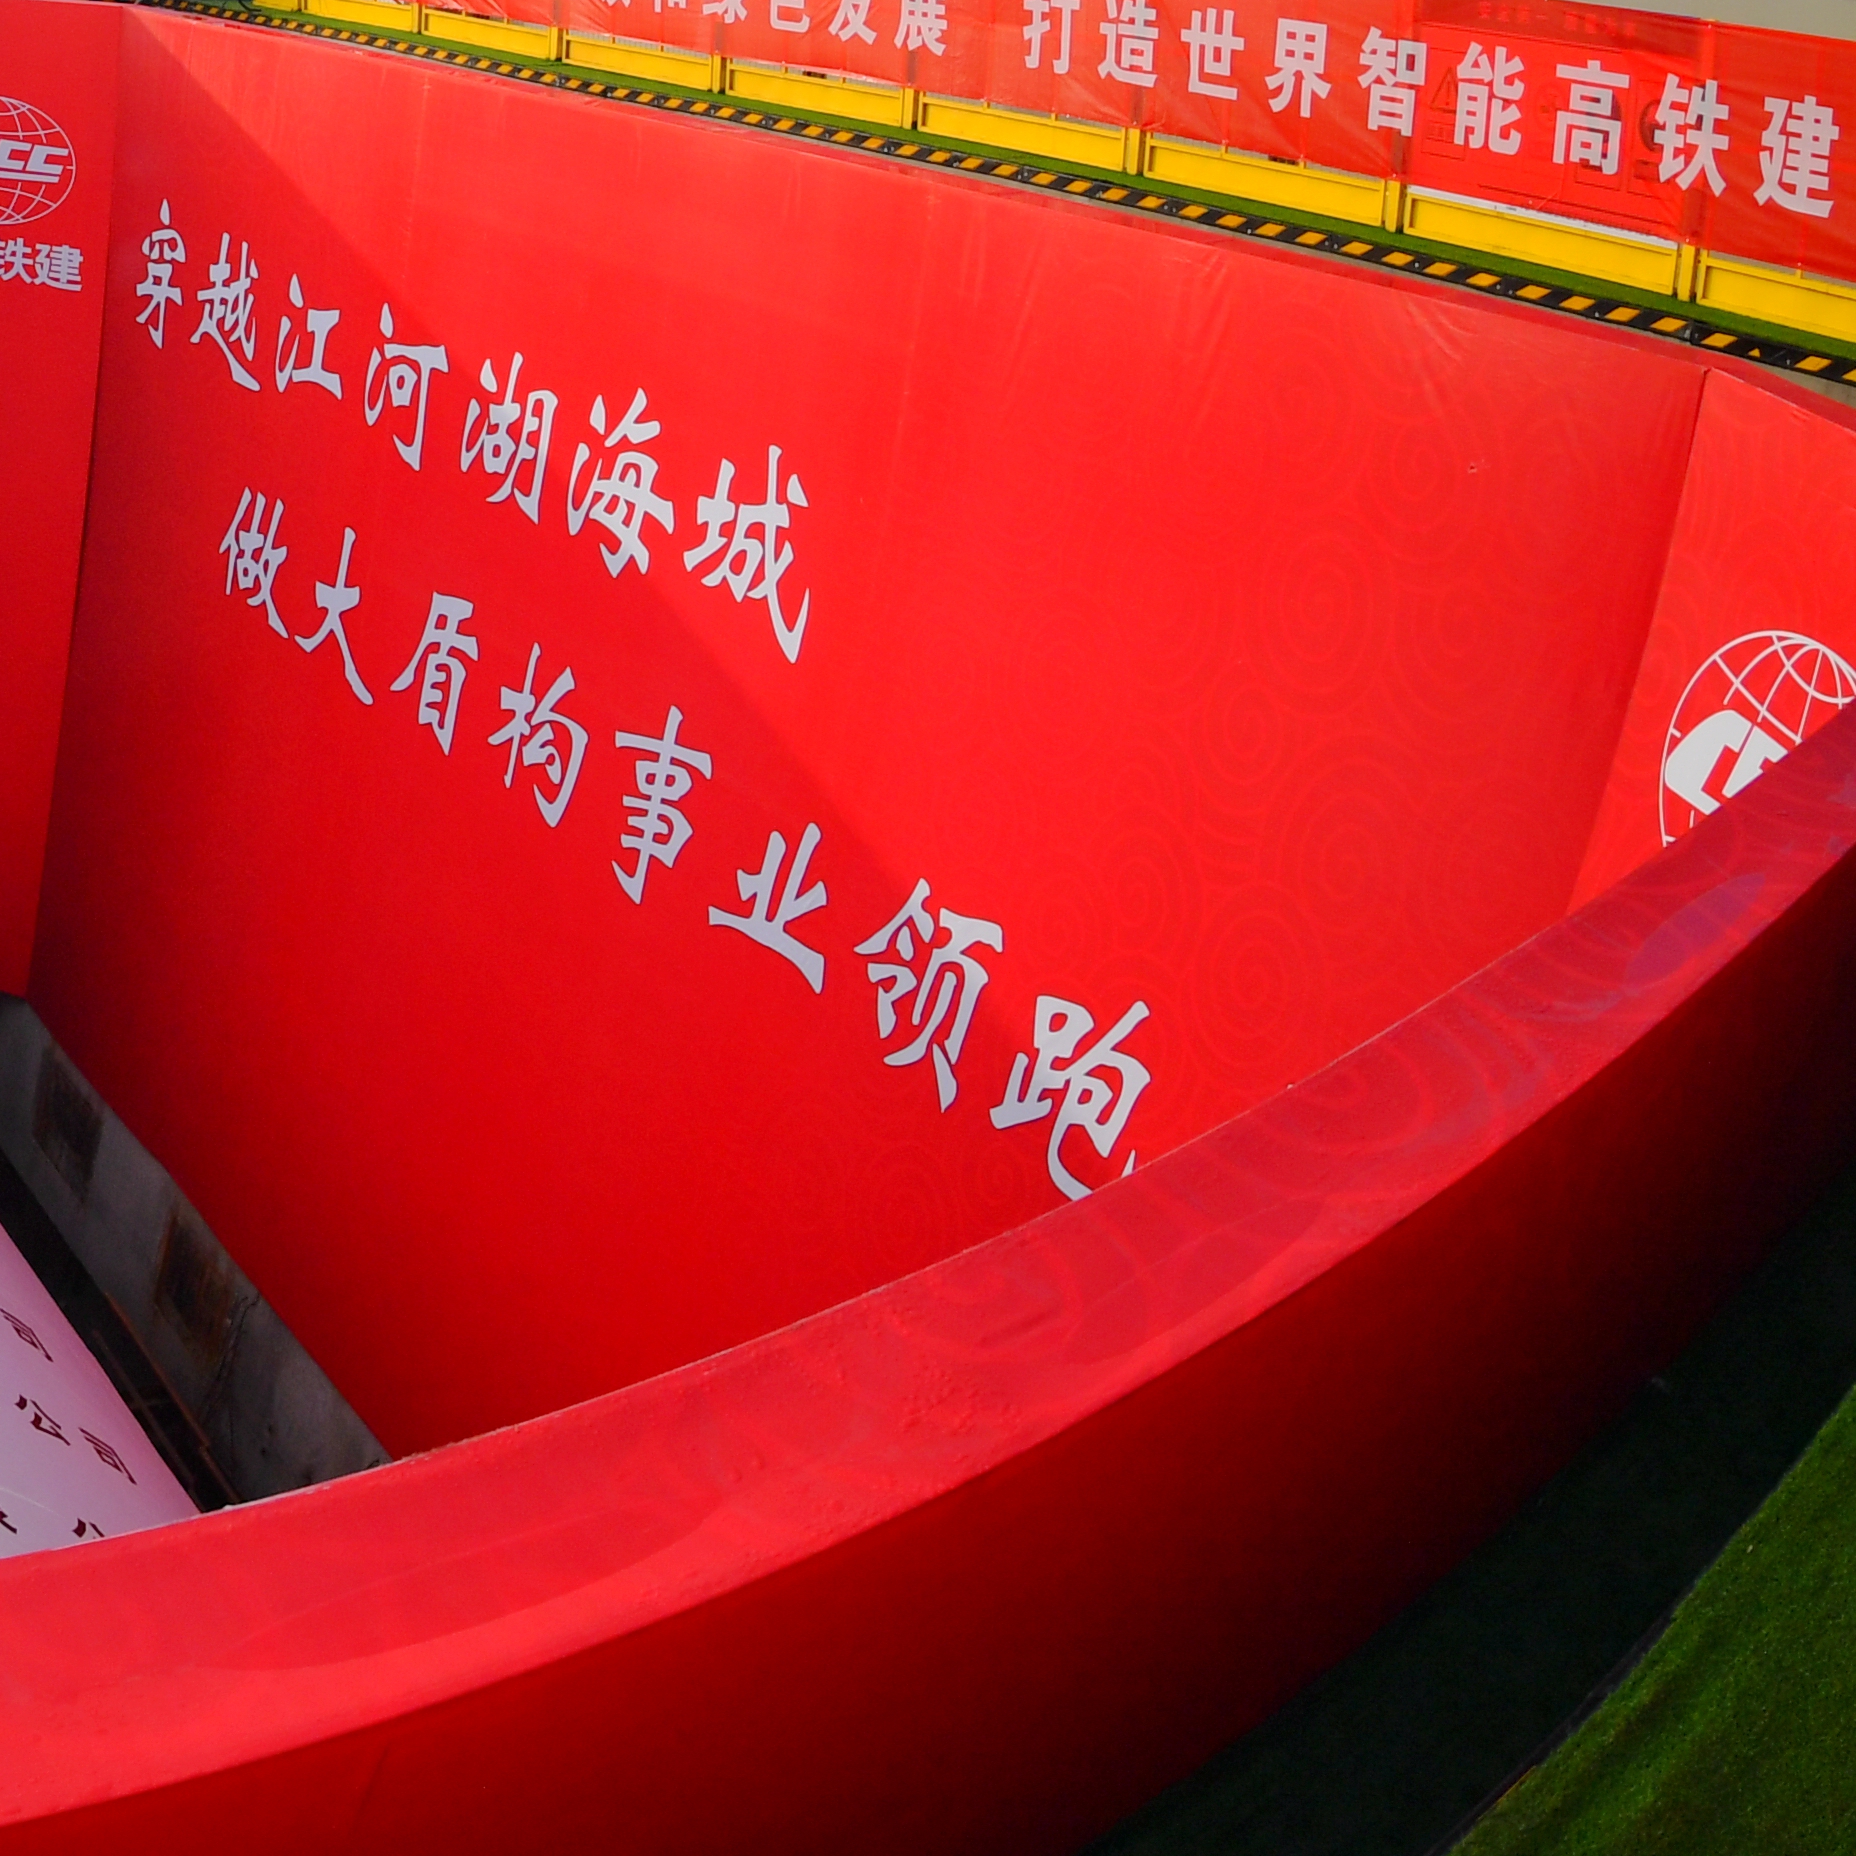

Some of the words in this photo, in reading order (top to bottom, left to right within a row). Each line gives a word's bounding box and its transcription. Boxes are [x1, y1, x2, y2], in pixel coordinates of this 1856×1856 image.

[135, 198, 811, 663] 穿越江河湖海城
[218, 486, 1150, 1202] 做大盾构事业领跑
